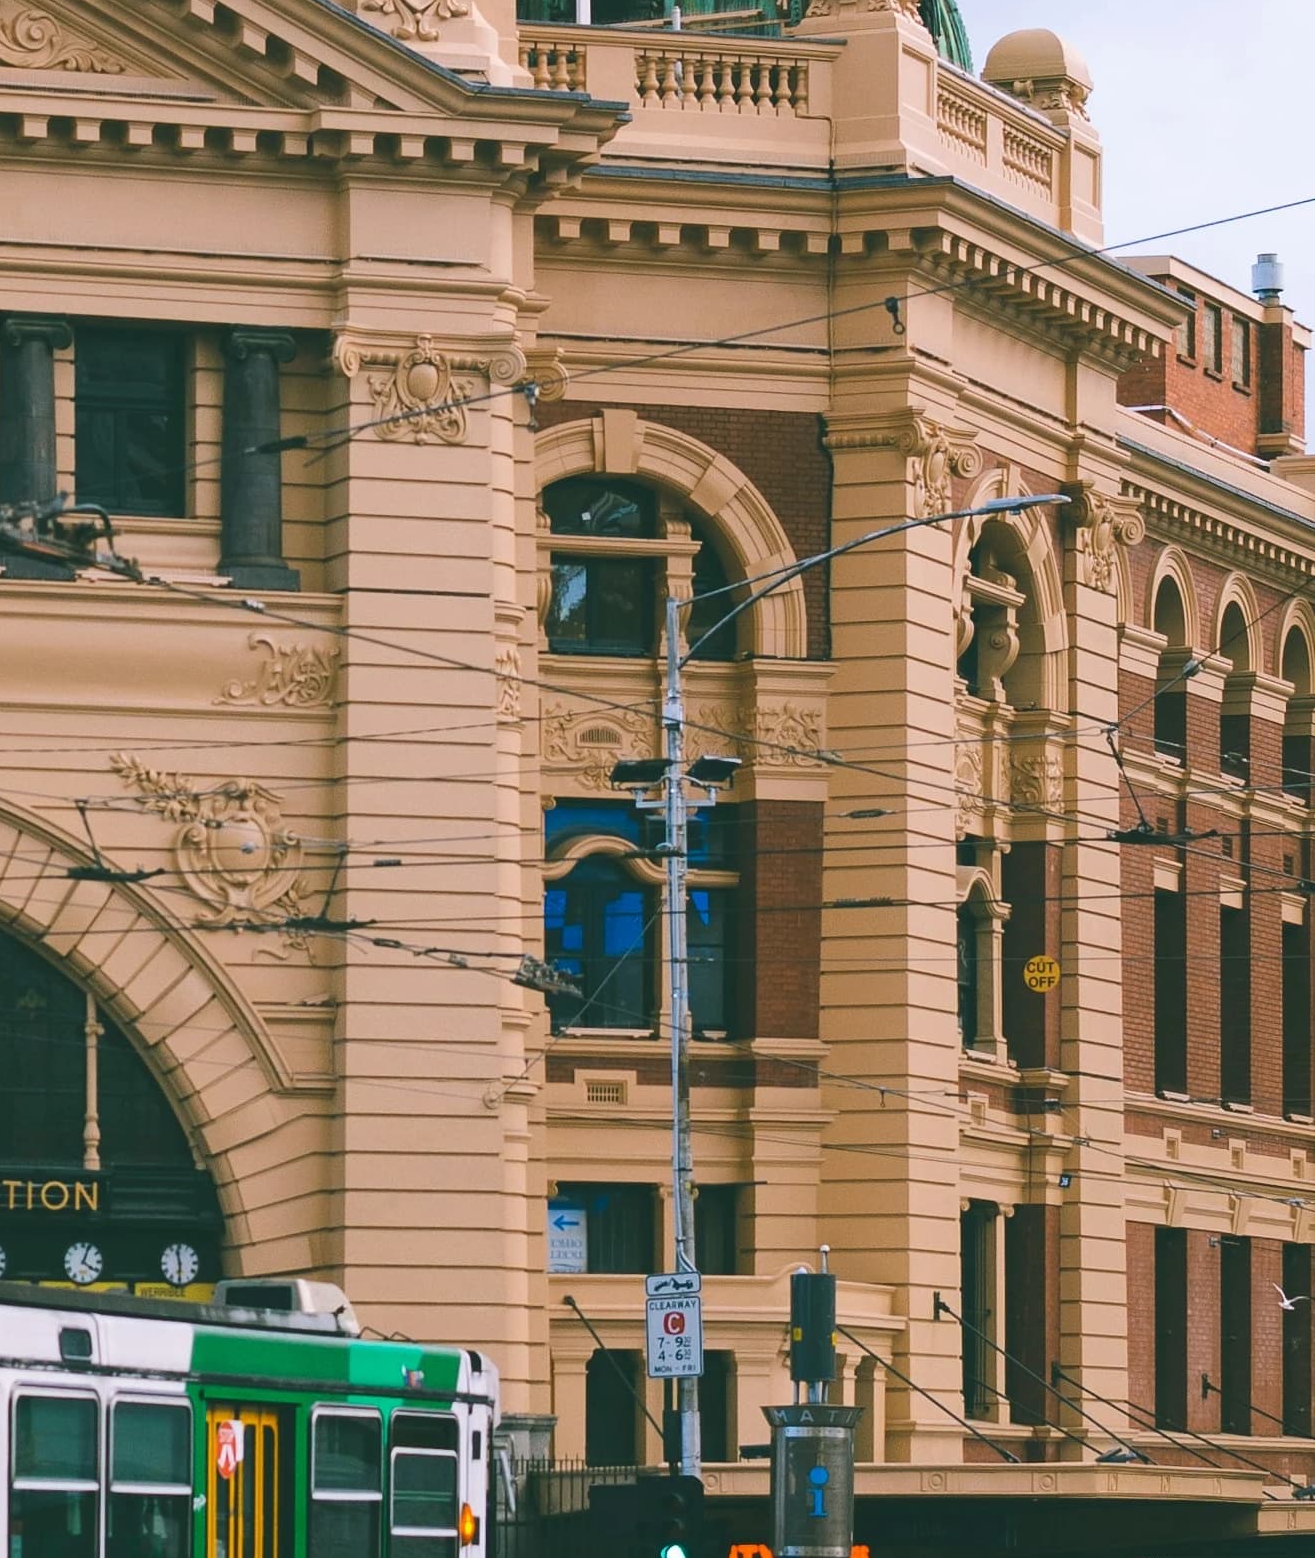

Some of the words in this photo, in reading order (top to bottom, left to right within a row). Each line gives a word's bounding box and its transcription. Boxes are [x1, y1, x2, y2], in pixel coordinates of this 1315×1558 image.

[1027, 962, 1054, 973] CUT
[1029, 977, 1055, 987] OFF
[649, 1300, 696, 1310] CLEARWAY
[668, 1313, 680, 1333] C
